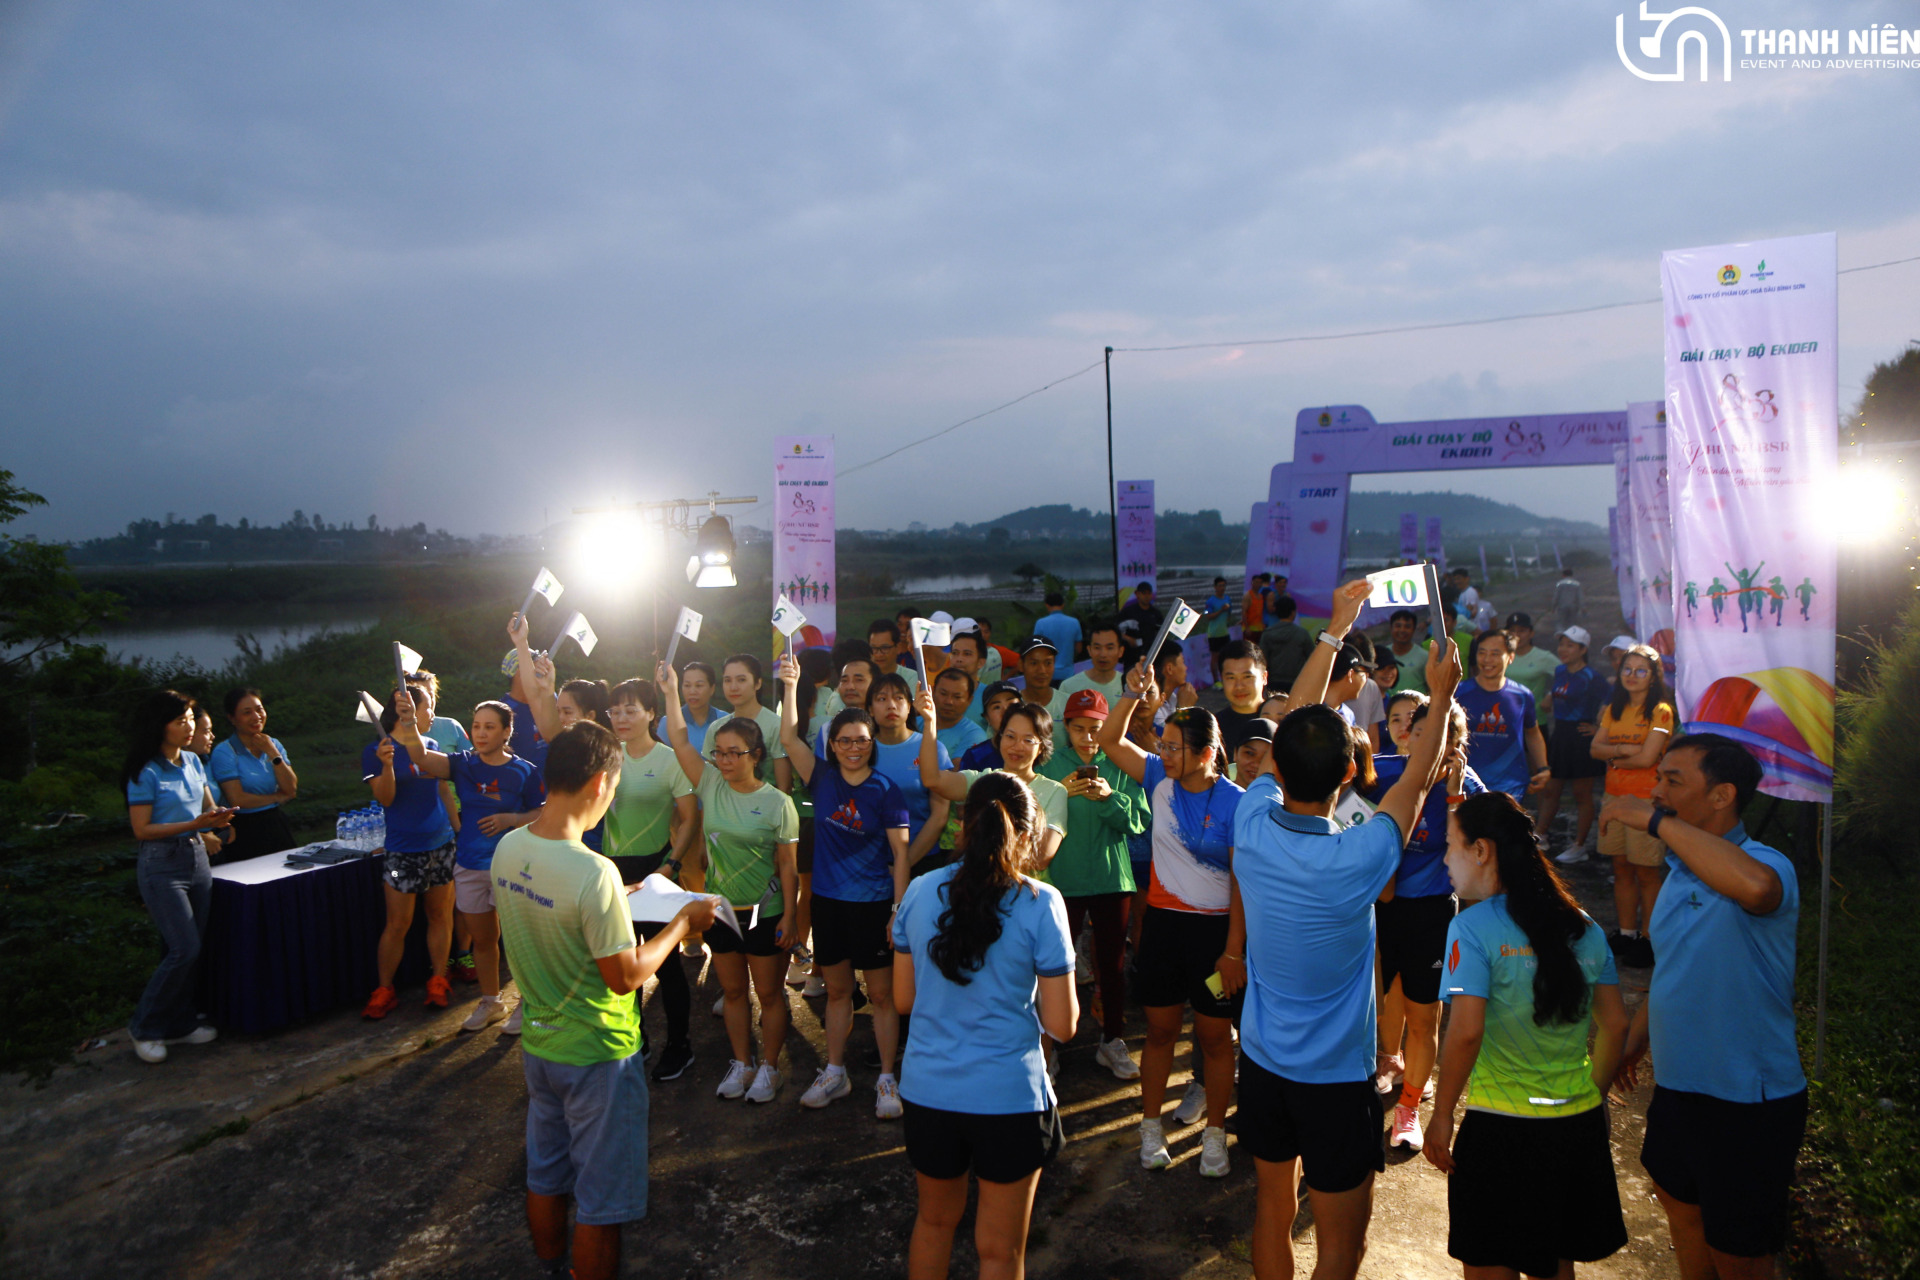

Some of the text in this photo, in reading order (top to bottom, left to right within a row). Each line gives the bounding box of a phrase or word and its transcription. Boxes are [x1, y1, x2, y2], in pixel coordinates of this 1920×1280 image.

[1747, 343, 1767, 360] BỘ
[1770, 341, 1818, 357] EKIDEN
[1427, 432, 1466, 446] CHẠY
[1472, 429, 1493, 444] BỘ
[1441, 446, 1493, 459] EKIDEN
[1299, 487, 1338, 499] START
[1382, 579, 1418, 604] 10
[773, 607, 787, 622] 6
[1175, 608, 1190, 625] 8
[920, 626, 931, 643] 7
